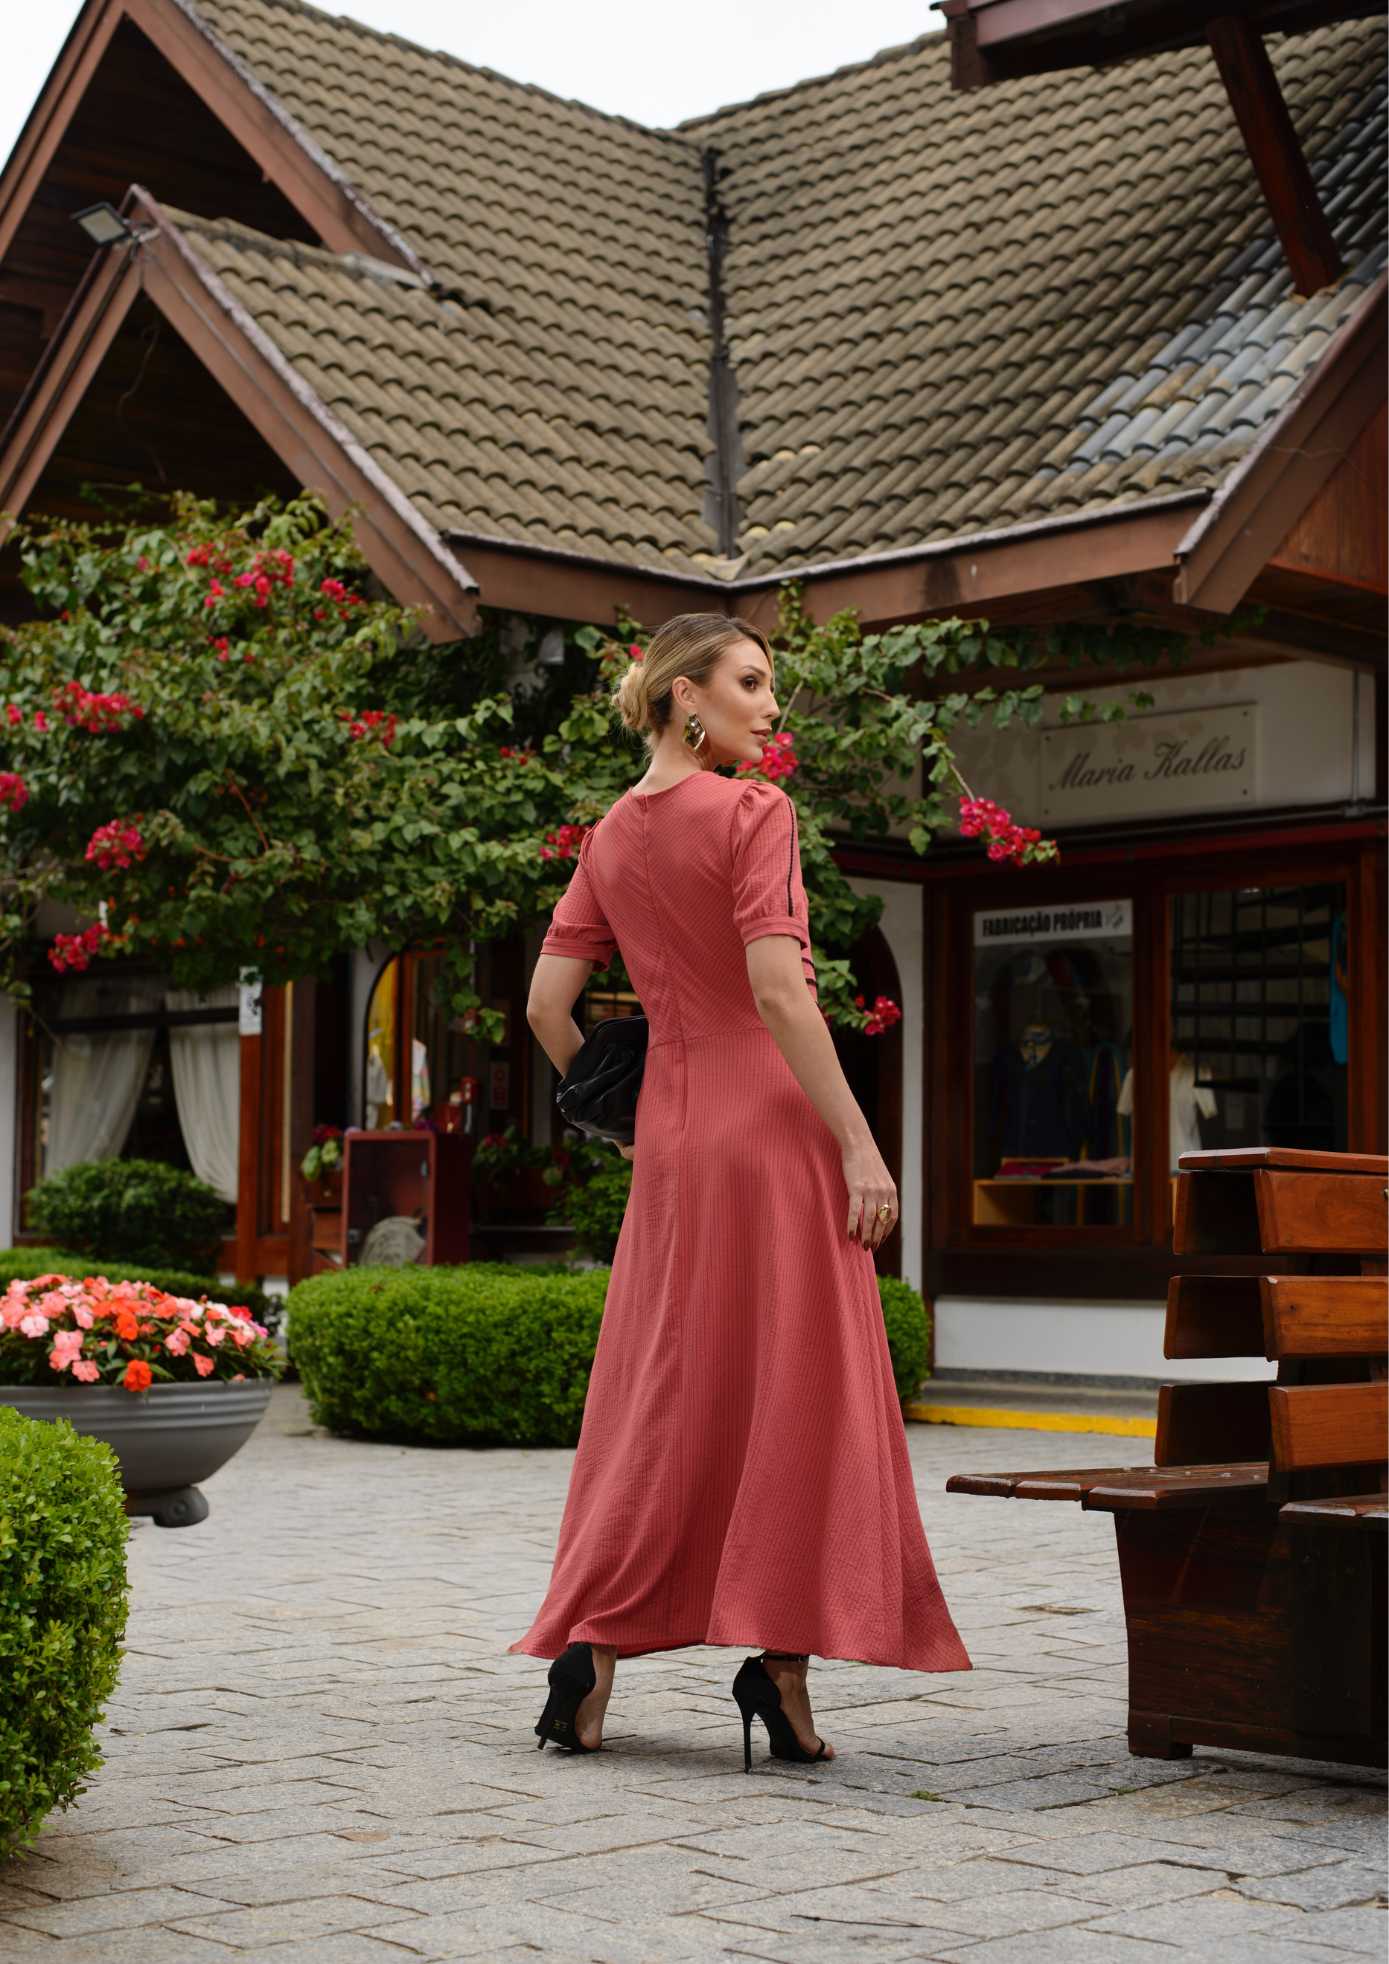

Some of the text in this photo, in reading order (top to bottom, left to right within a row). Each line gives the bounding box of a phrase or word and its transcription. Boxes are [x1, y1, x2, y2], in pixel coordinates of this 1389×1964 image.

[1049, 735, 1247, 790] Maria Kallas
[982, 908, 1102, 937] FABRICAÇÃO PRÓPRIA
